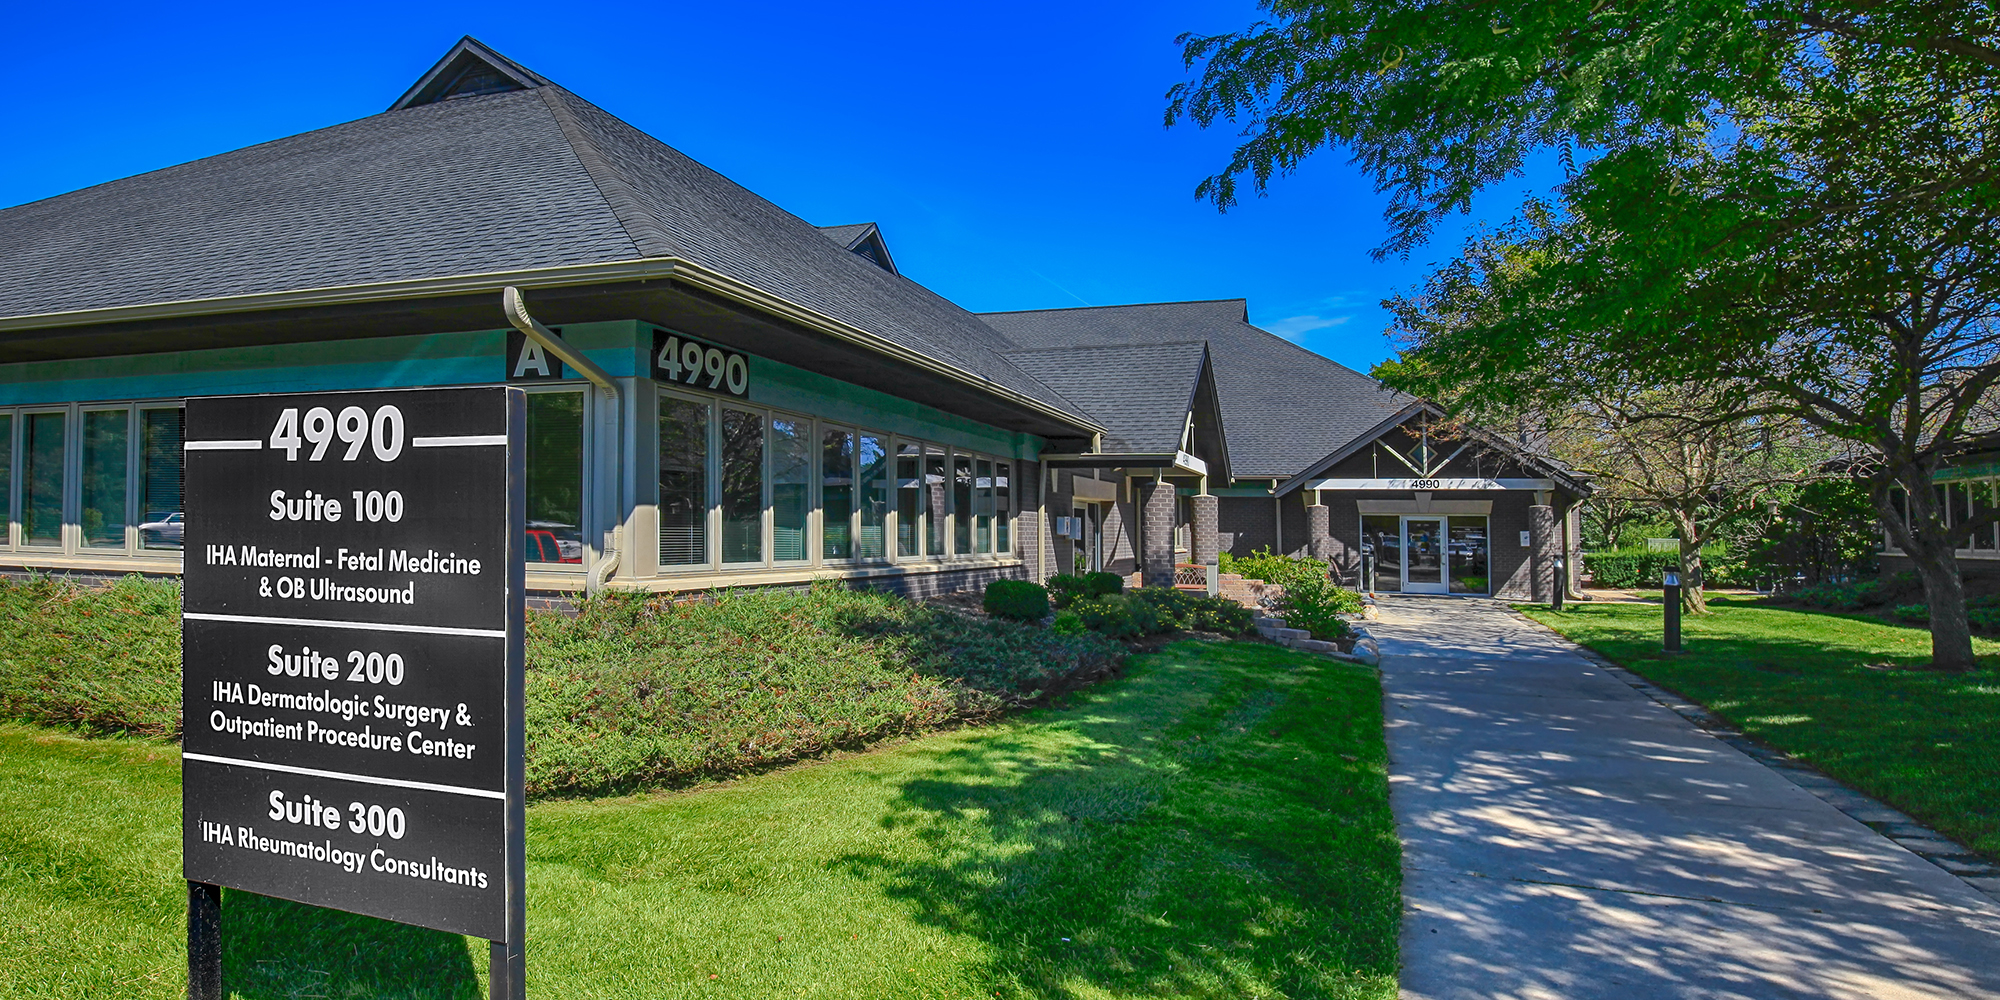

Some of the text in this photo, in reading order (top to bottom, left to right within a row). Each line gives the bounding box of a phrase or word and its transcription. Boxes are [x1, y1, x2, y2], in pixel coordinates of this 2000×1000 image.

[513, 336, 550, 377] A
[657, 336, 748, 395] 4990
[270, 405, 404, 461] 4990
[269, 489, 404, 522] Suite 100
[1412, 479, 1440, 489] 4990
[206, 544, 237, 565] IHA
[241, 545, 320, 569] Maternal
[338, 548, 382, 571] Fetal
[389, 550, 481, 575] Medicine
[259, 576, 414, 604] & OB Ultrasound
[267, 644, 404, 685] Suite 200
[213, 681, 471, 730] IHA Dermatologic Surgery &
[210, 710, 475, 759] Outpatient Procedure Center
[269, 790, 406, 839] Suite 300
[203, 822, 488, 889] IHA Rheumatology Consultants
